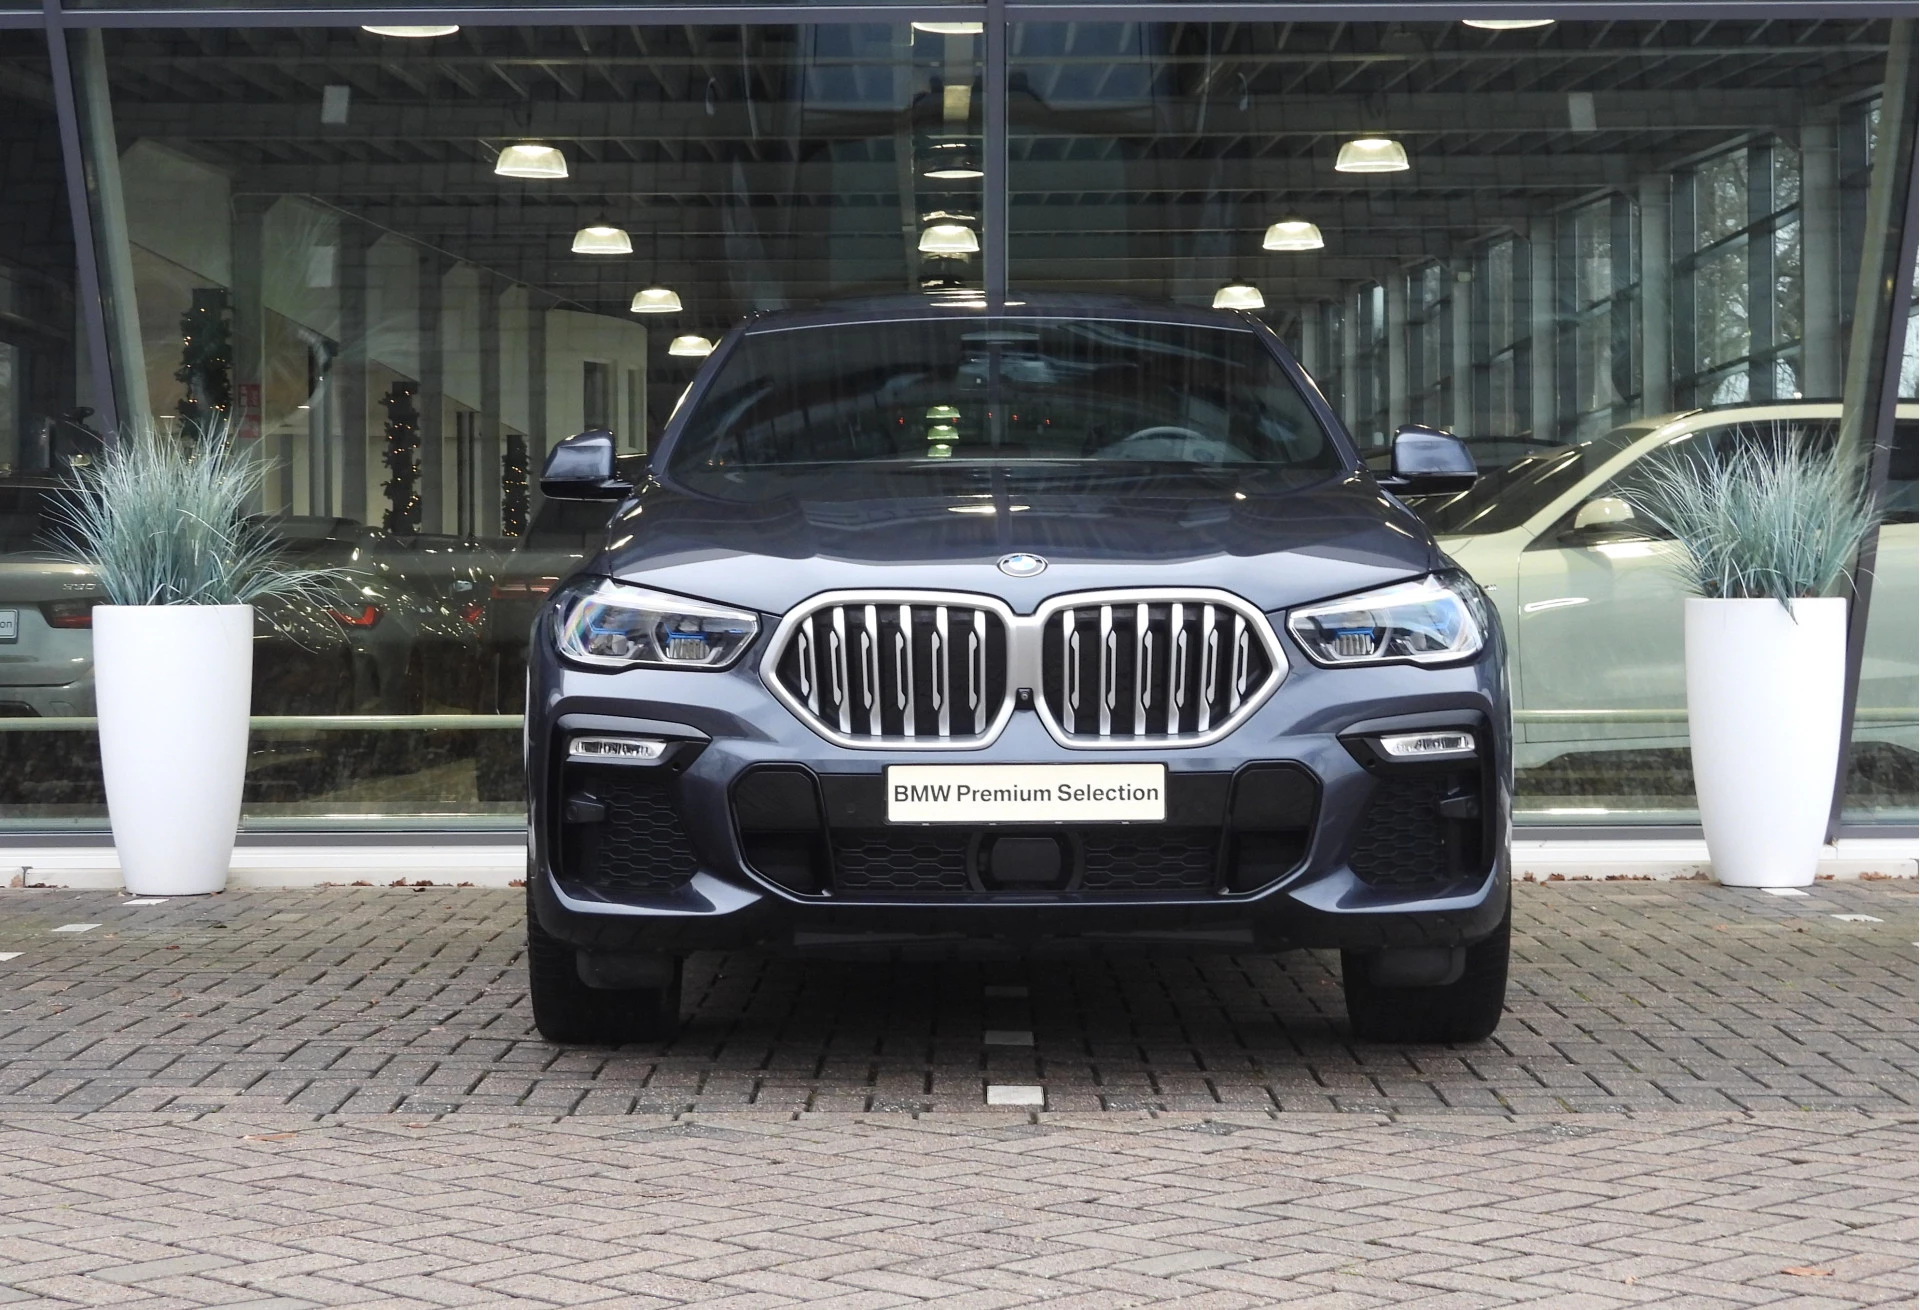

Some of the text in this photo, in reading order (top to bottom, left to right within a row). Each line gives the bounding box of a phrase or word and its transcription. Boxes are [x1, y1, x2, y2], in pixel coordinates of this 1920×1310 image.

[894, 783, 1159, 802] BMW Premium Selection
